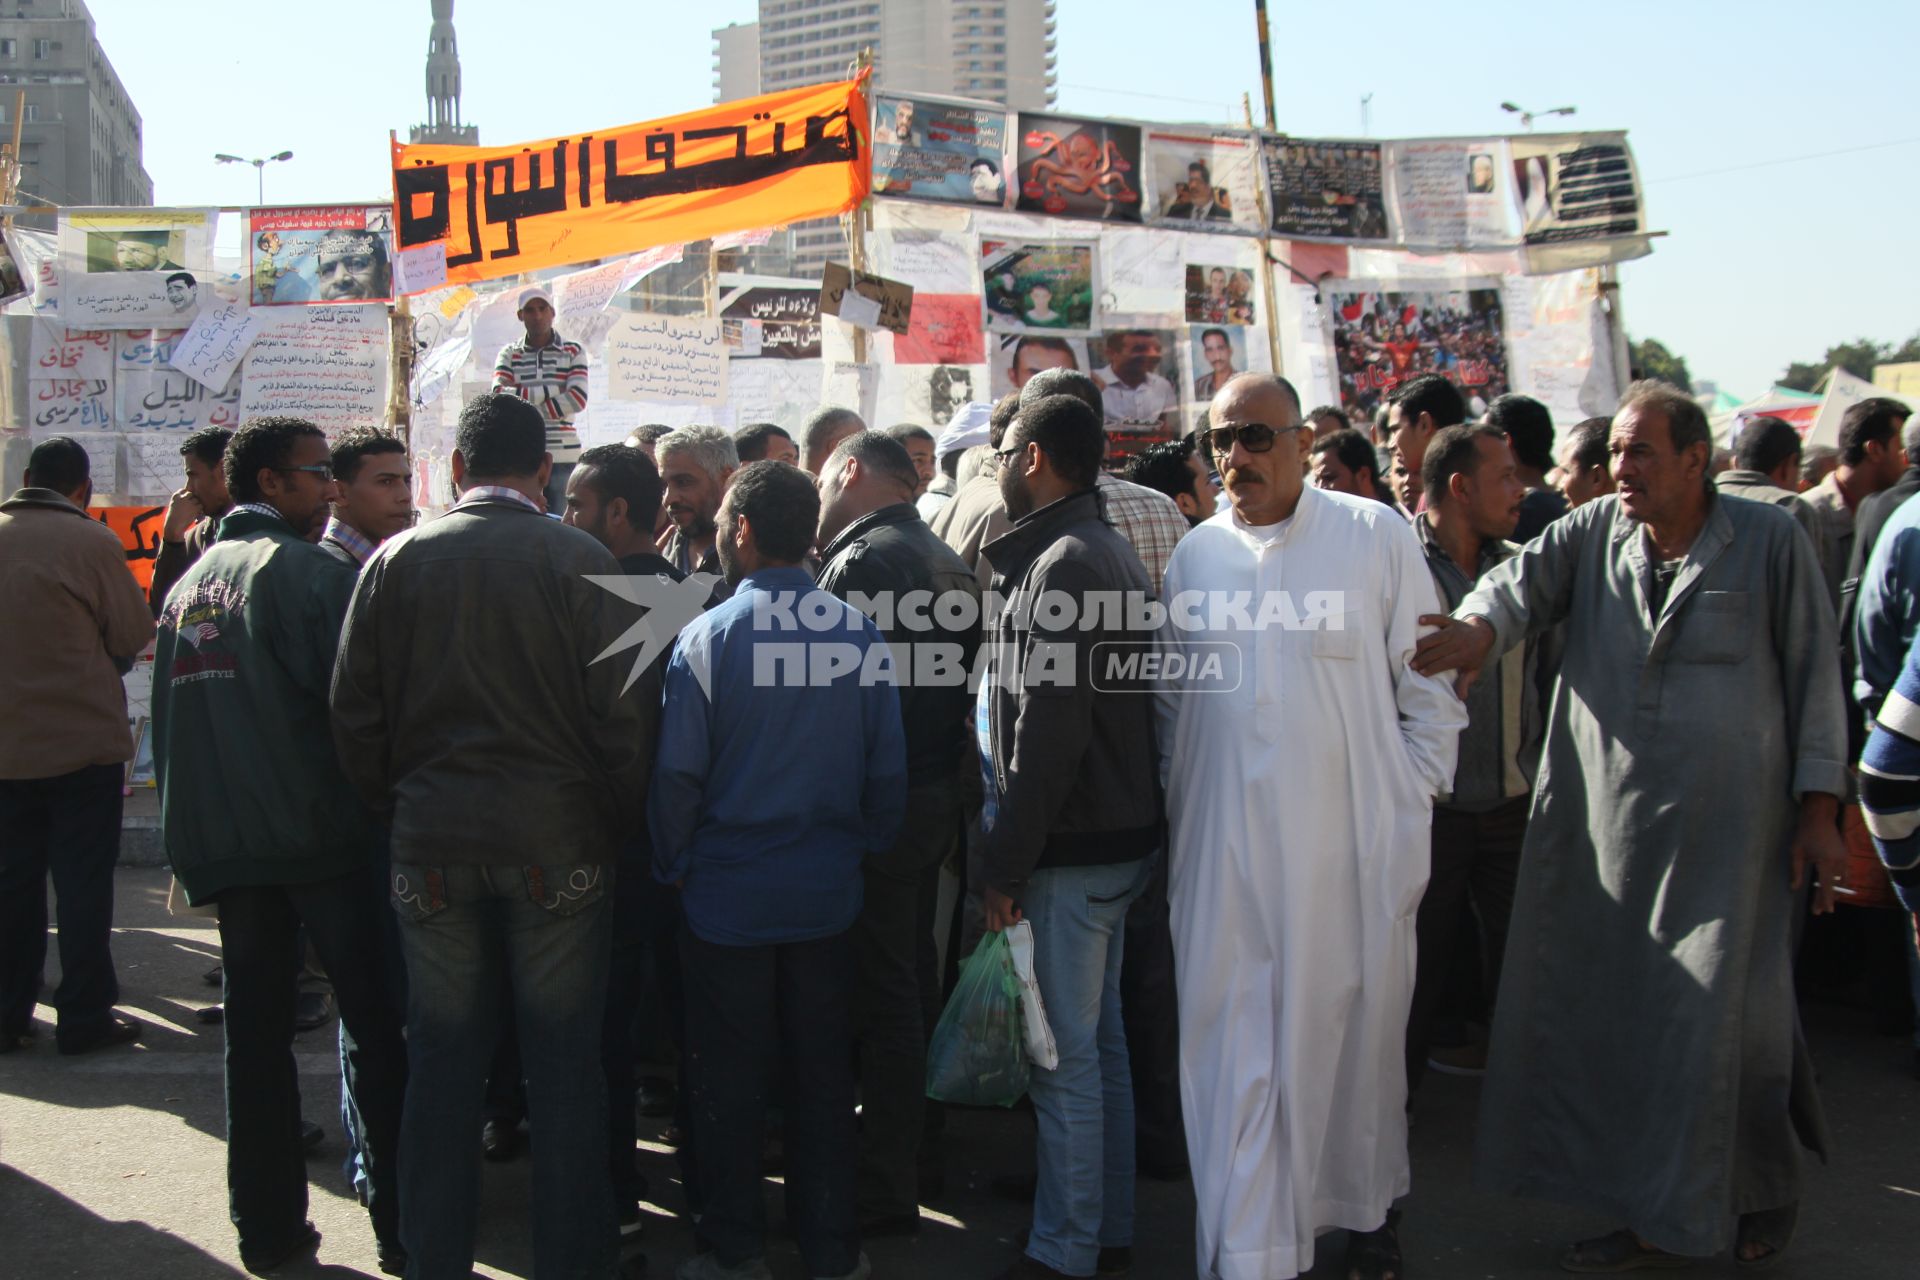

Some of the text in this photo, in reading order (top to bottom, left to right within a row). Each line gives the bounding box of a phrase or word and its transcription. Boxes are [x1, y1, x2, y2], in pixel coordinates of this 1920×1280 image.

[395, 107, 858, 268] متحف الثورة
[751, 295, 787, 318] للرئيس
[703, 326, 720, 345] لن
[762, 323, 798, 348] بالتعيين
[39, 345, 84, 368] نخاف
[36, 401, 79, 427] مرسى
